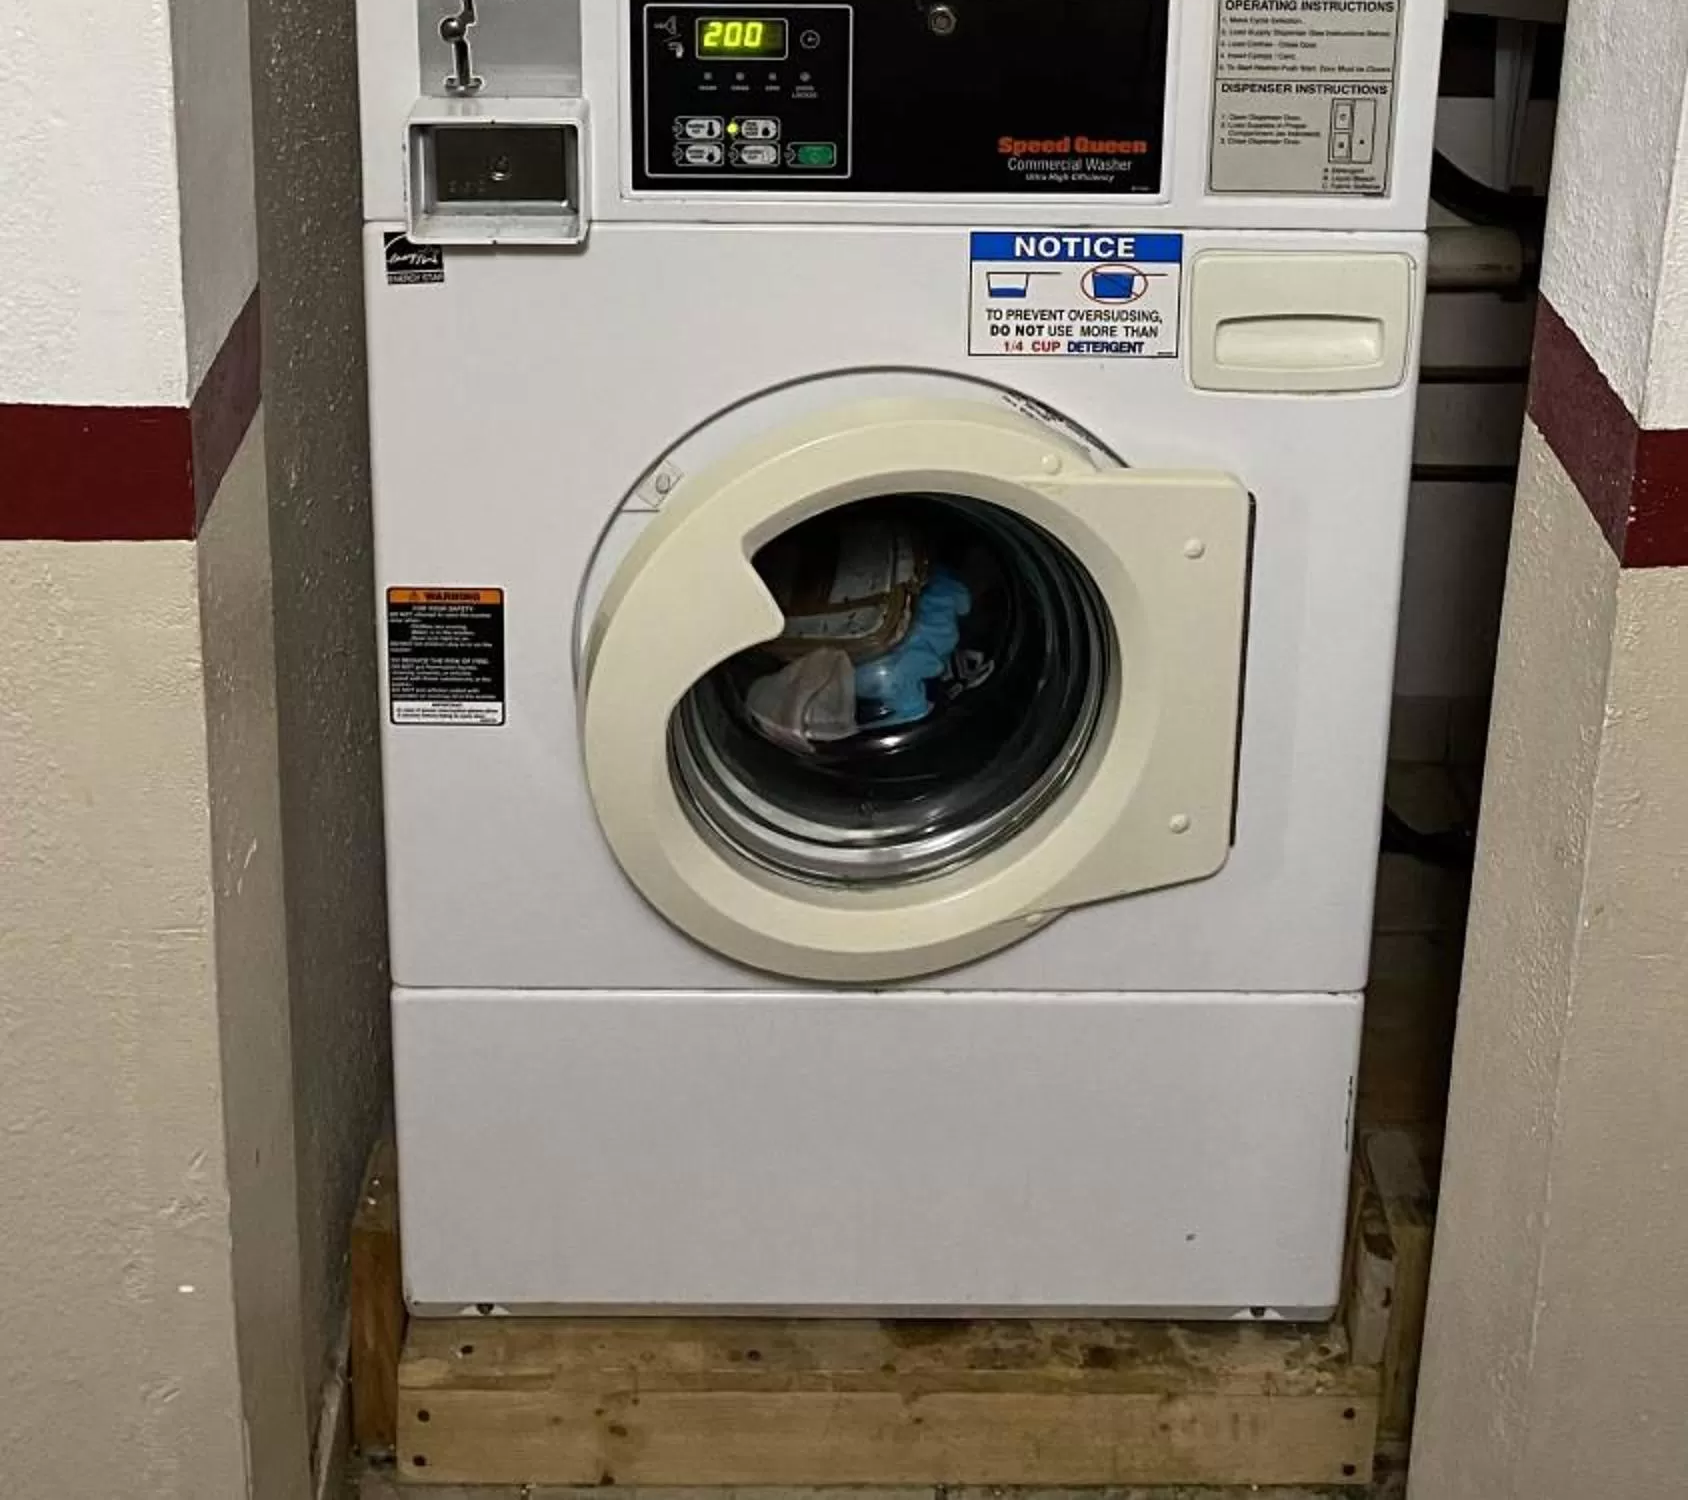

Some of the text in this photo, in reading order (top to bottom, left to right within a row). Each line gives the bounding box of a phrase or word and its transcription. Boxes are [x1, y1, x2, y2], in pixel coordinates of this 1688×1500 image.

[1225, 0, 1395, 13] OPERATING INSTRUCTIONS
[703, 21, 764, 48] 200
[1221, 83, 1389, 95] DISPENSER INSTRUCTIONS
[998, 136, 1148, 156] Speed Queen
[1007, 157, 1133, 172] Commercial Washer
[1048, 173, 1069, 183] High
[1014, 236, 1136, 258] NOTICE
[986, 309, 1163, 324] TO PREVENT OVERSUDSING,
[990, 325, 1159, 338] DO NOT USE MORE THAN
[1003, 340, 1024, 352] 1/4
[1031, 341, 1061, 352] CUP
[1067, 341, 1145, 354] DETERGENT
